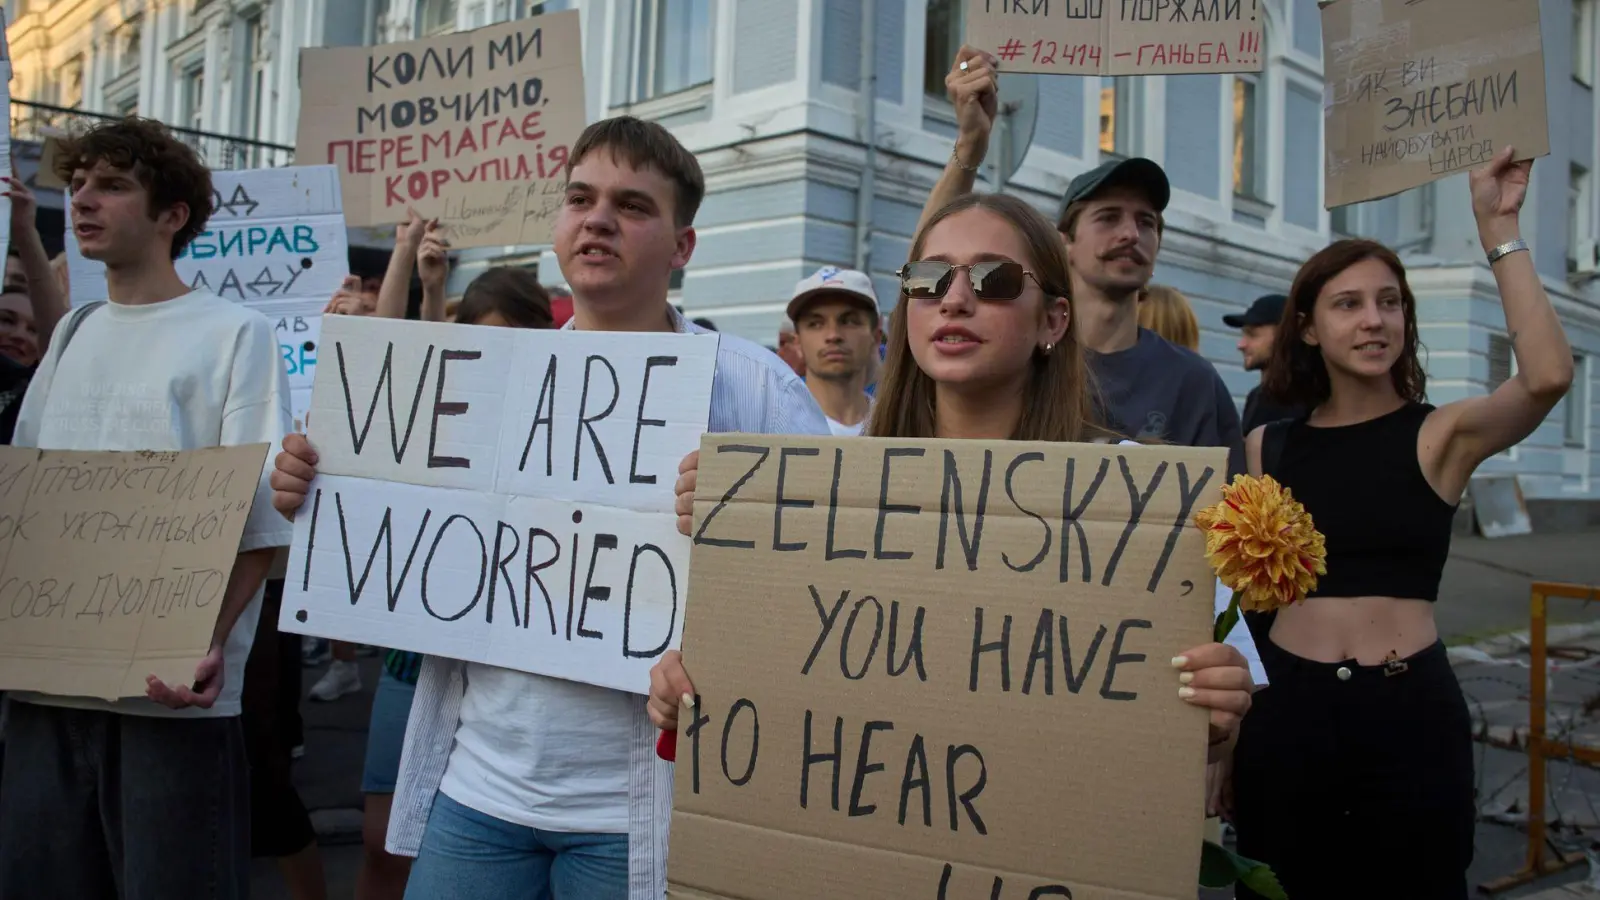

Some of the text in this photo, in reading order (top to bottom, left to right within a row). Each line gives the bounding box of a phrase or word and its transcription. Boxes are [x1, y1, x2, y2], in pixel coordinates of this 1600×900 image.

[367, 28, 542, 93] КОЛИ МИ
[997, 37, 1102, 67] #12414
[1356, 56, 1435, 102] ЯК ВИ
[357, 77, 549, 134] МОВЧИМО,
[327, 111, 546, 174] ПЕРЕМАГАЄ
[1428, 138, 1493, 172] НАРОД
[178, 225, 319, 259] БИРАВ
[335, 340, 679, 485] WE ARE
[33, 465, 235, 500] ПРОПУСТИЛИ
[693, 444, 1215, 597] ZELENSKYY,
[0, 576, 75, 621] СОВА
[801, 584, 1153, 701] YOU HAVE
[800, 708, 988, 836] HEAR
